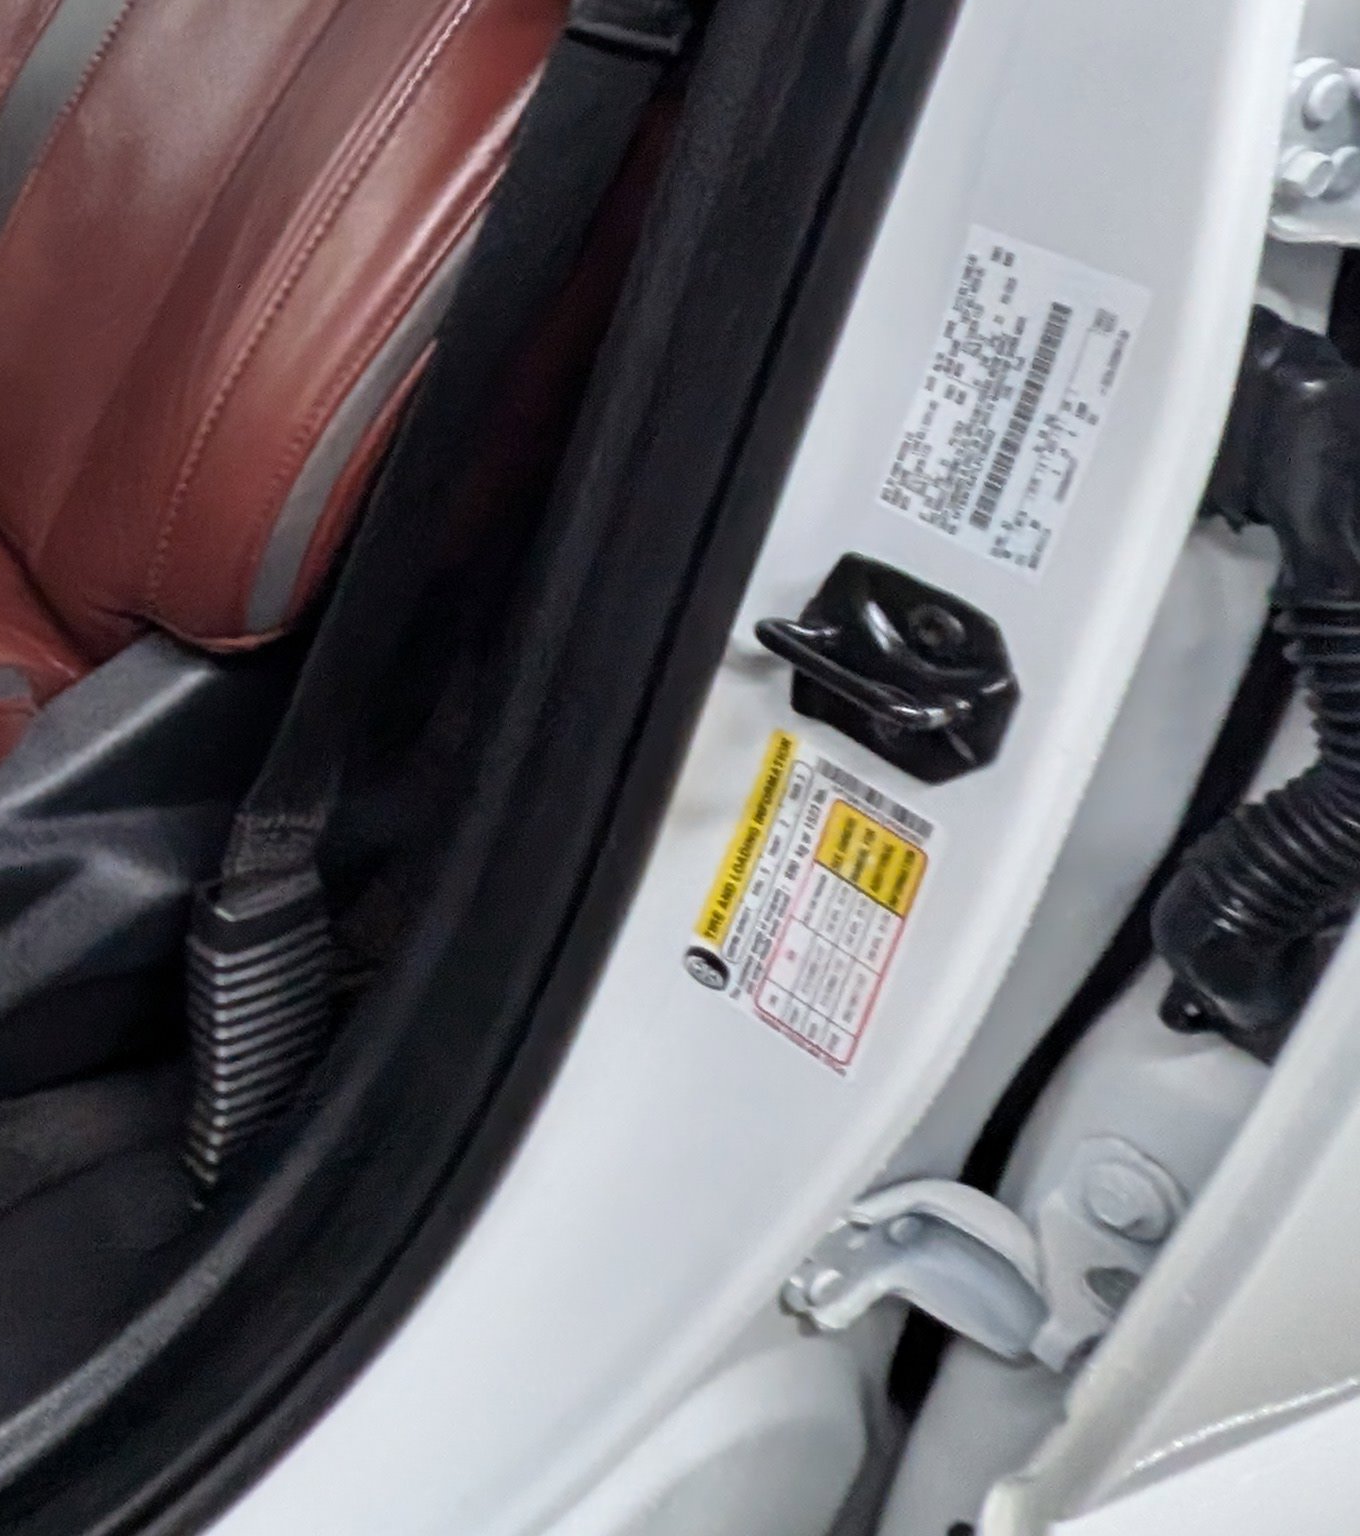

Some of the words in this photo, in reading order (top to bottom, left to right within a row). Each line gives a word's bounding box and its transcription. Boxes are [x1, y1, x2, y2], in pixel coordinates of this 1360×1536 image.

[717, 883, 736, 909] AND
[730, 827, 759, 882] LOADING
[753, 737, 792, 826] INFORMATION
